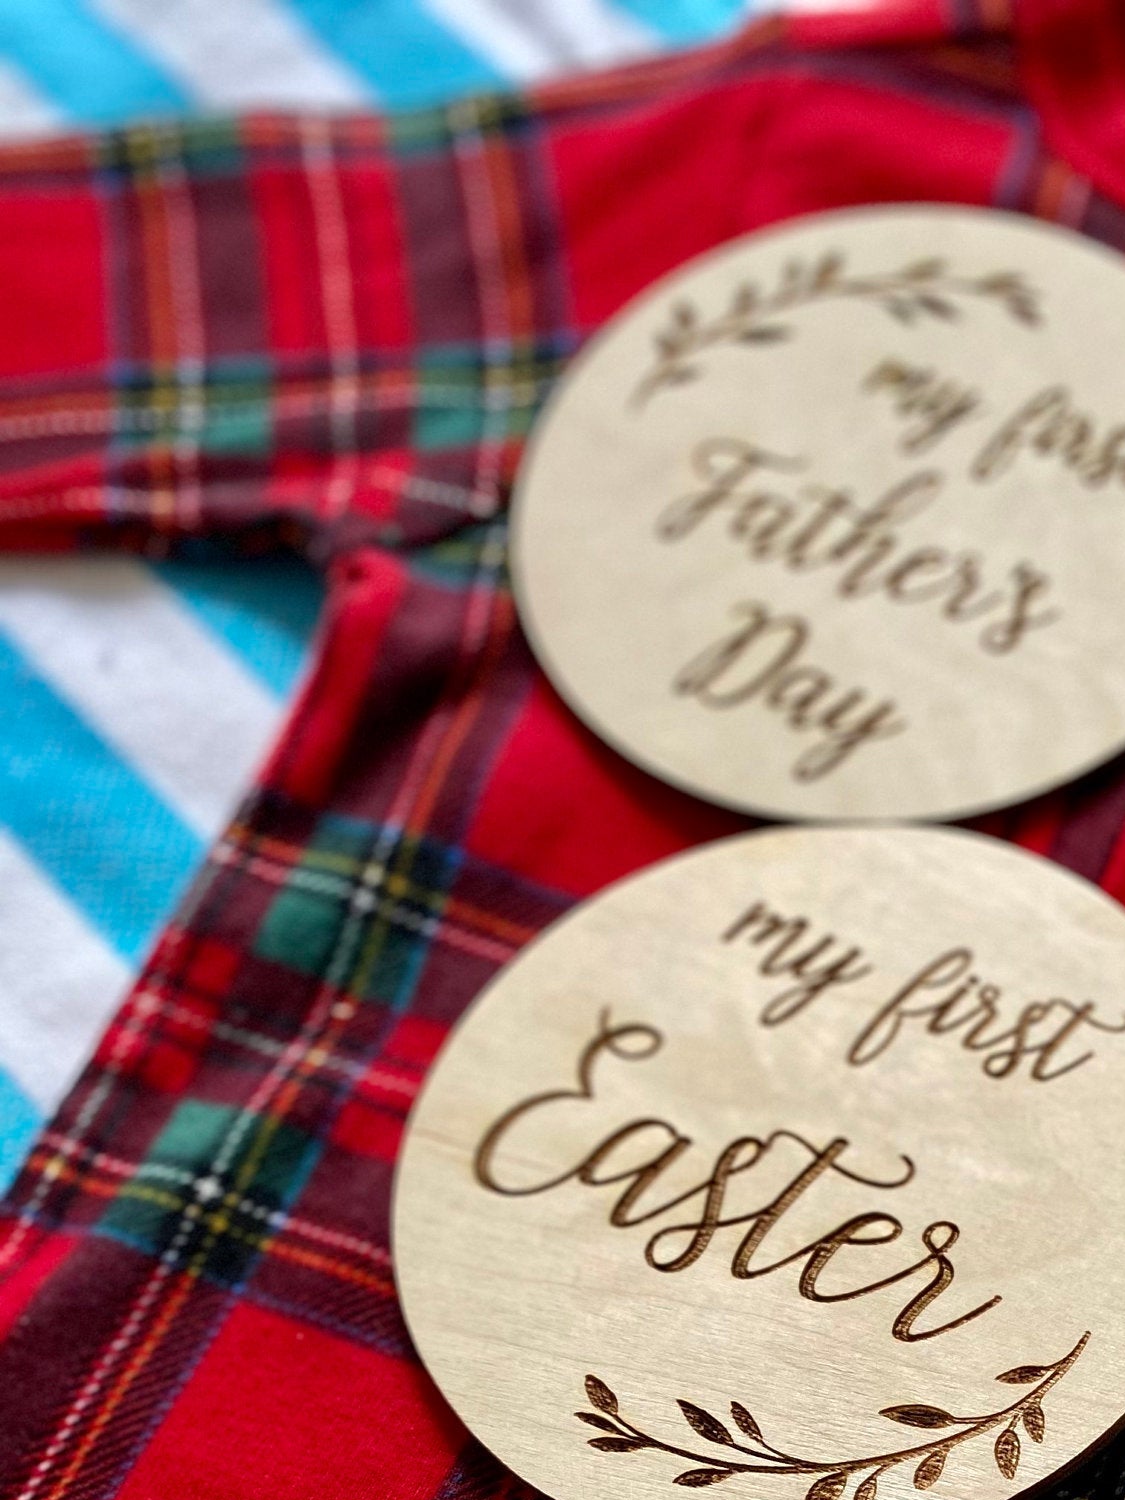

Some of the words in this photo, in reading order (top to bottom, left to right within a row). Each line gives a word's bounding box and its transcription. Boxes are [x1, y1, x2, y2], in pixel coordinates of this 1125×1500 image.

[860, 358, 982, 458] my
[671, 601, 907, 784] Day
[721, 900, 873, 1028] my
[472, 1005, 1003, 1343] Easter
